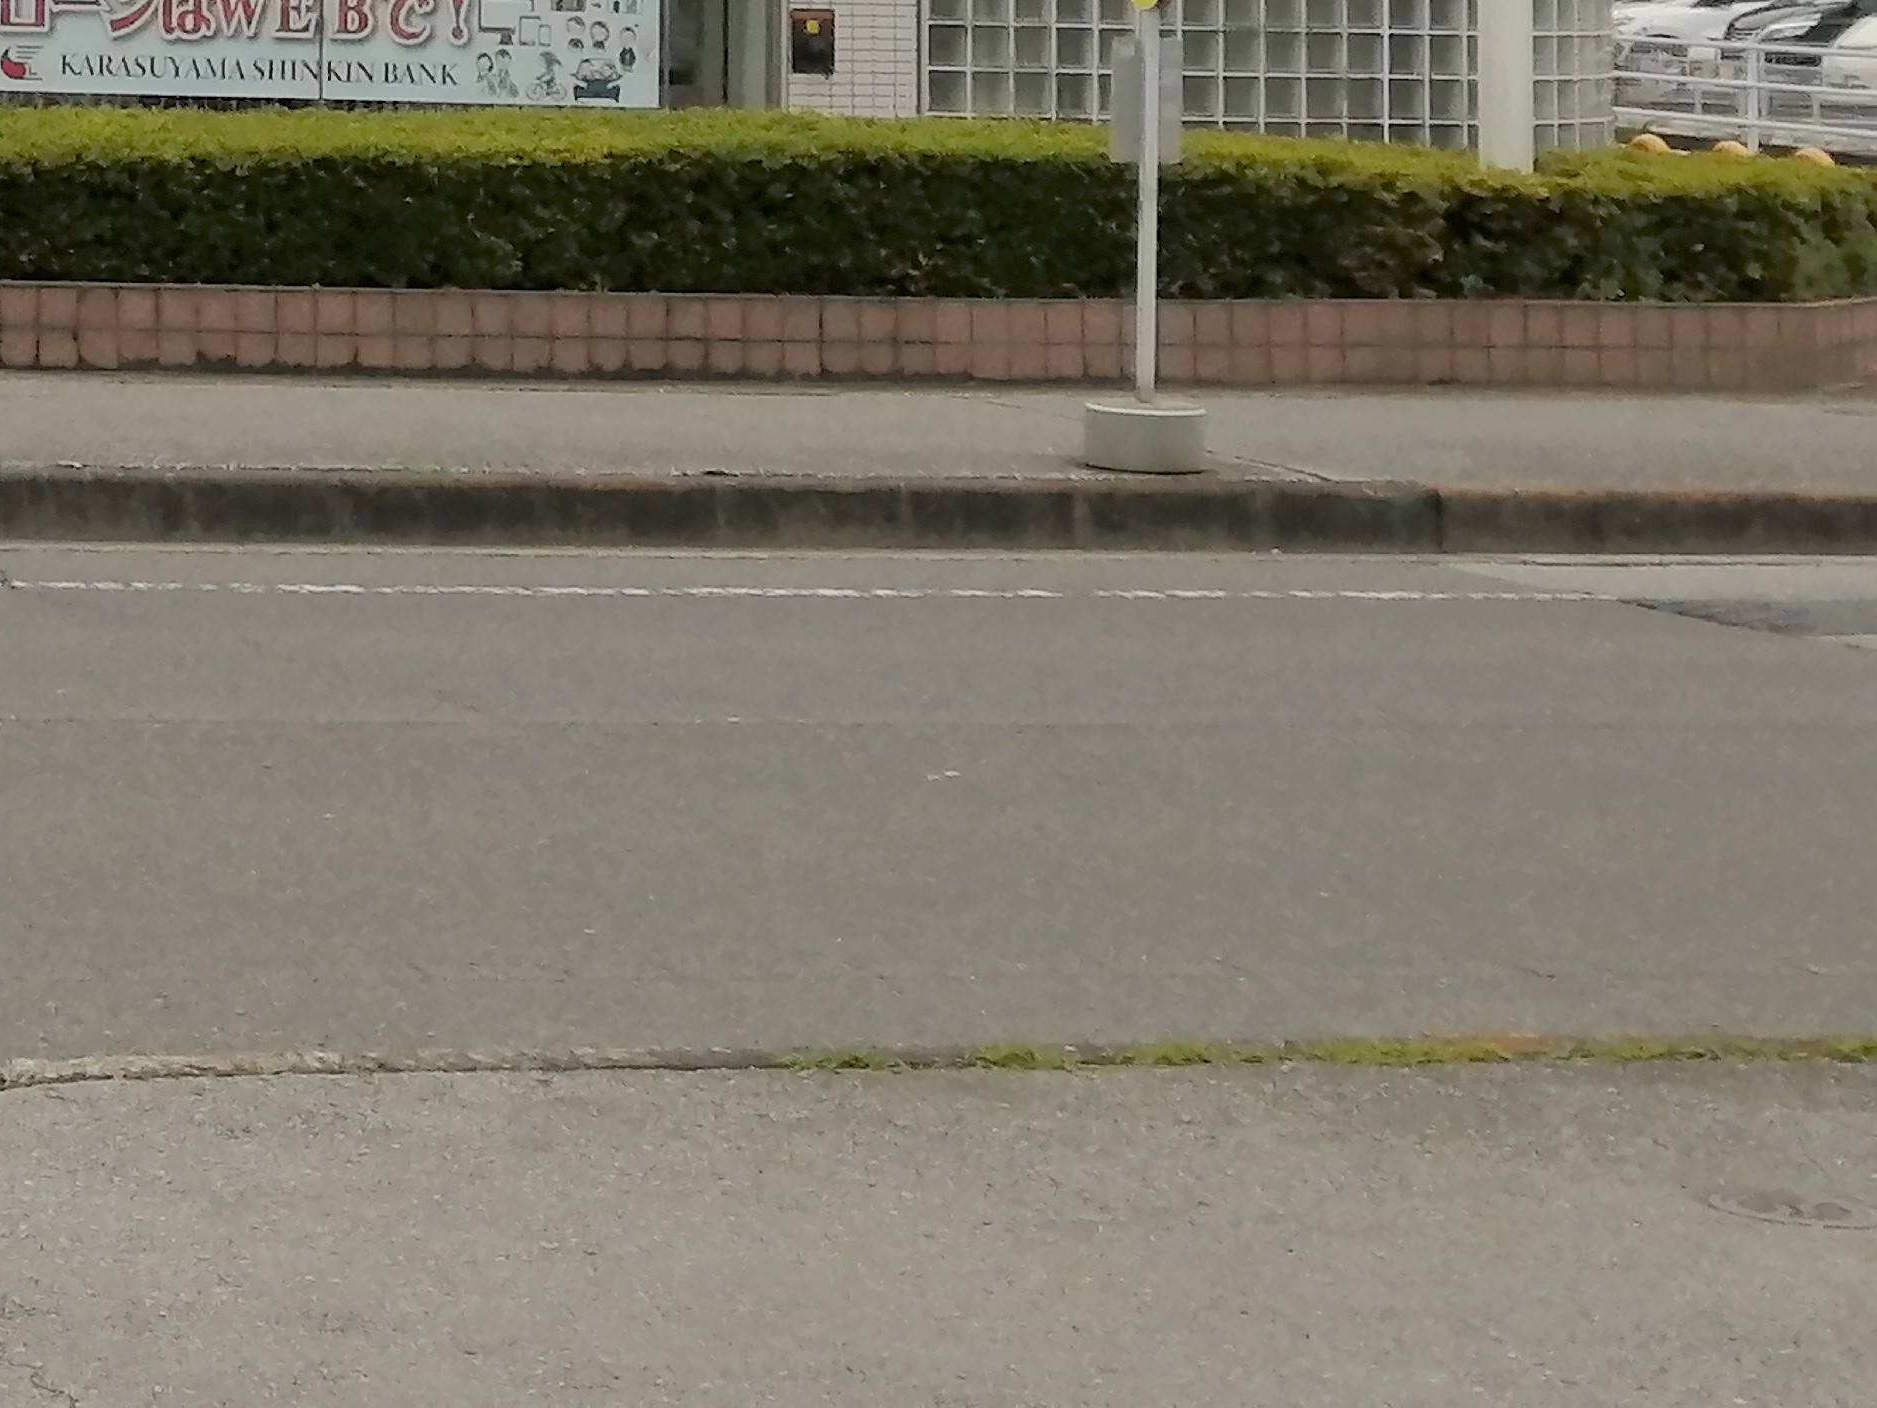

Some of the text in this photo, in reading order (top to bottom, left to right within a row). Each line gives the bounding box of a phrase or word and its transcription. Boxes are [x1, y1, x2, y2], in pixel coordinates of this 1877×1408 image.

[60, 52, 459, 86] KARASUYAMA SHINKIN BANK
